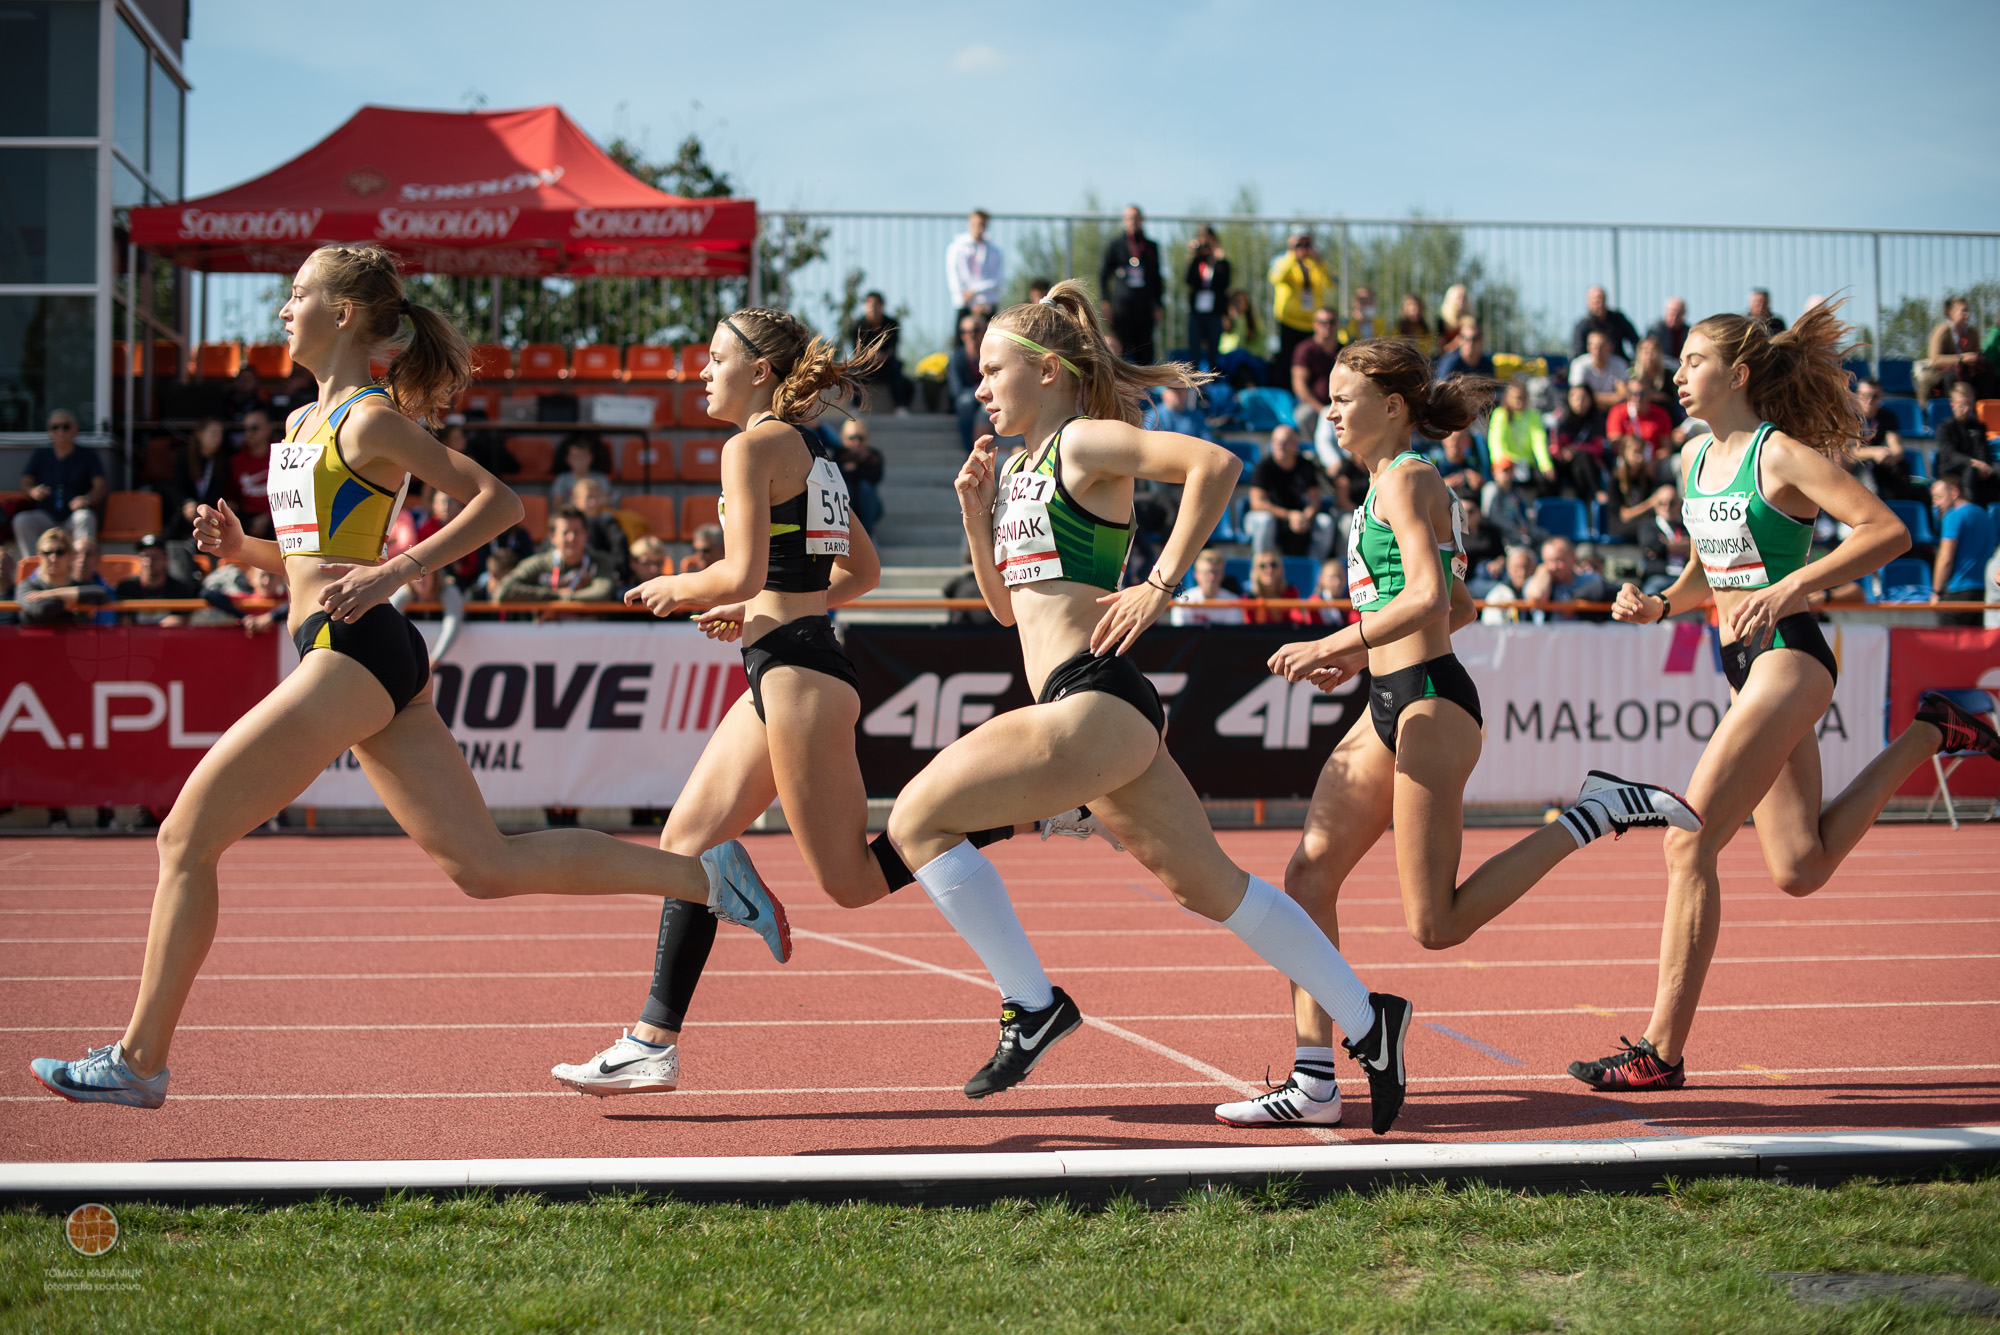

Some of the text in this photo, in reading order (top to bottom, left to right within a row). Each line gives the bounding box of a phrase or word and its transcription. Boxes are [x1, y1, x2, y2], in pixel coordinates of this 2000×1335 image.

[374, 205, 520, 239] SOKOŁÓW
[280, 446, 319, 471] 327
[1011, 477, 1047, 502] 621
[821, 489, 850, 528] 515
[1709, 501, 1742, 522] 656
[1019, 565, 1041, 580] 2019
[1728, 573, 1751, 586] 2019
[432, 663, 655, 731] OVE
[862, 671, 1014, 749] 4F
[1214, 671, 1363, 749] 4F
[1504, 699, 1849, 742] MAŁOPOA
